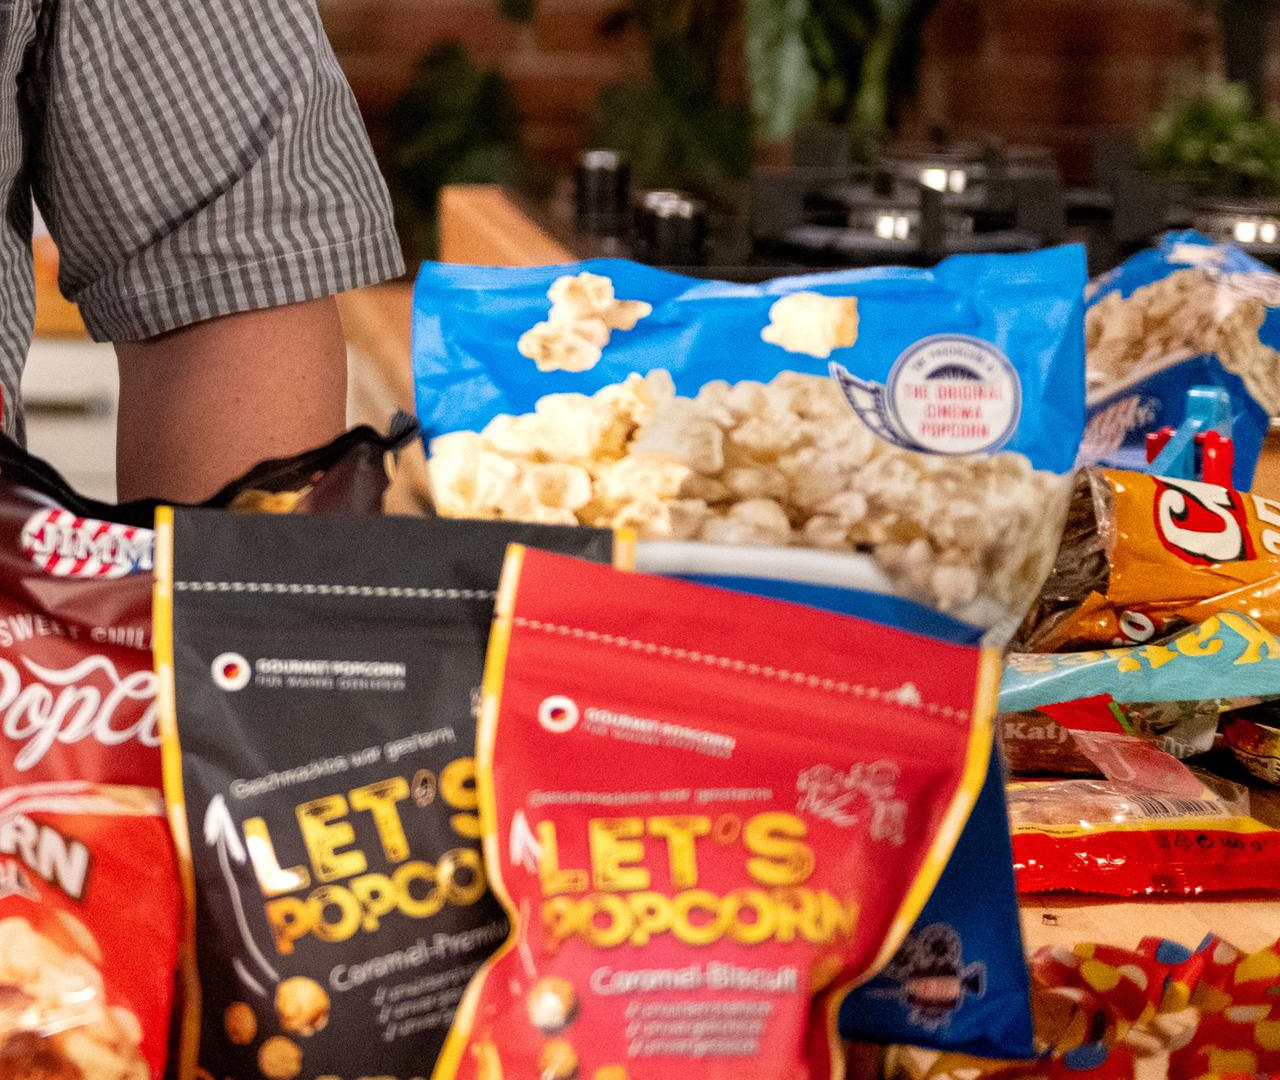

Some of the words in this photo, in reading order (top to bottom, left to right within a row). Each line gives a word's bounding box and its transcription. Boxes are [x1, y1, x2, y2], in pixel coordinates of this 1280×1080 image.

[920, 421, 990, 439] POPCORN
[32, 521, 155, 571] JIMM
[536, 811, 816, 899] LET'S
[265, 847, 487, 956] POPCO
[542, 887, 860, 958] POPCORN
